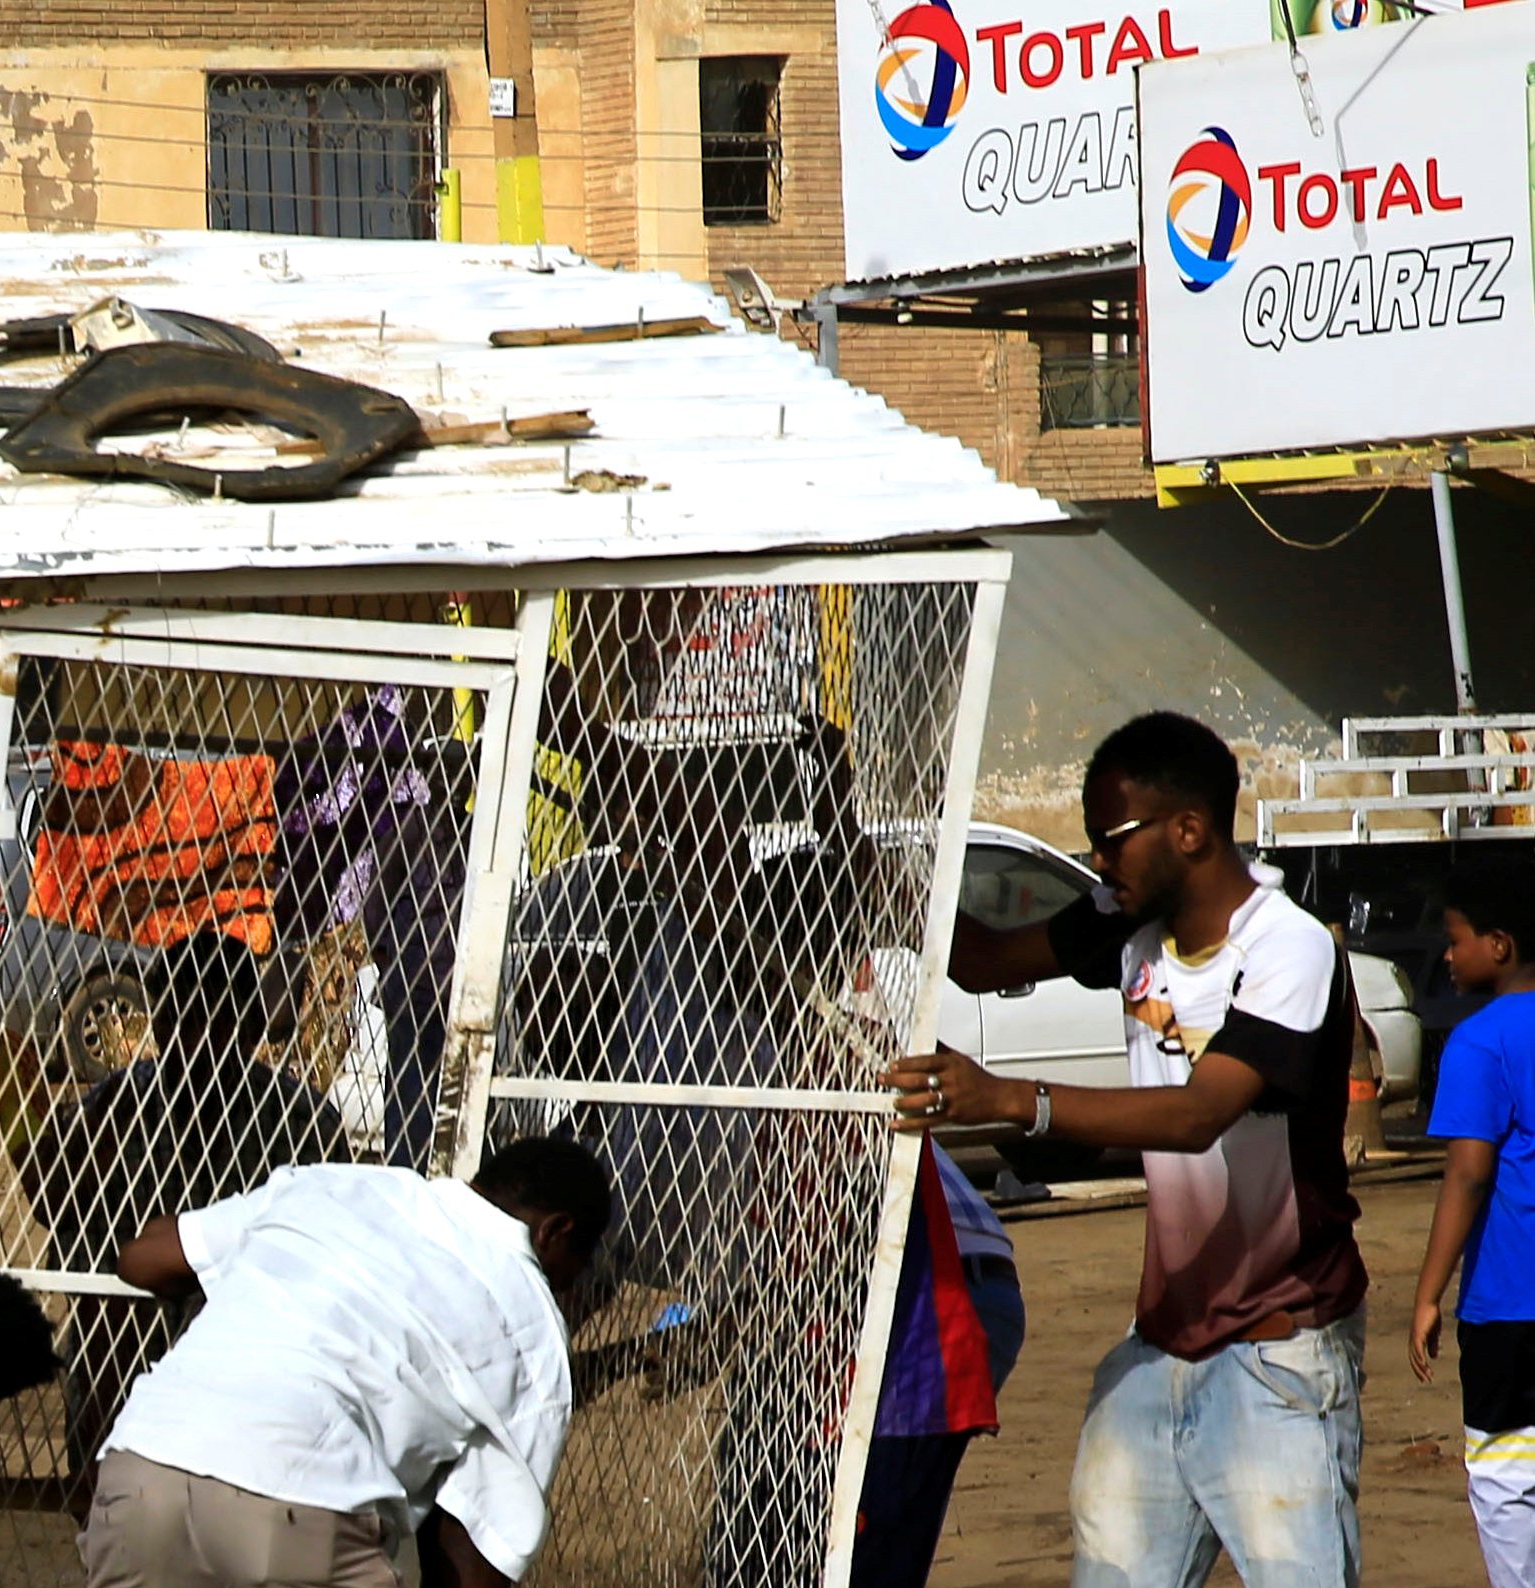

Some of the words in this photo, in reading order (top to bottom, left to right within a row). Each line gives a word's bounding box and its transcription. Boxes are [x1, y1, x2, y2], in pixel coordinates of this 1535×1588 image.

[976, 10, 1198, 94] TOTAL
[1258, 158, 1463, 232] TOTAL
[1242, 237, 1513, 351] QUARTZ
